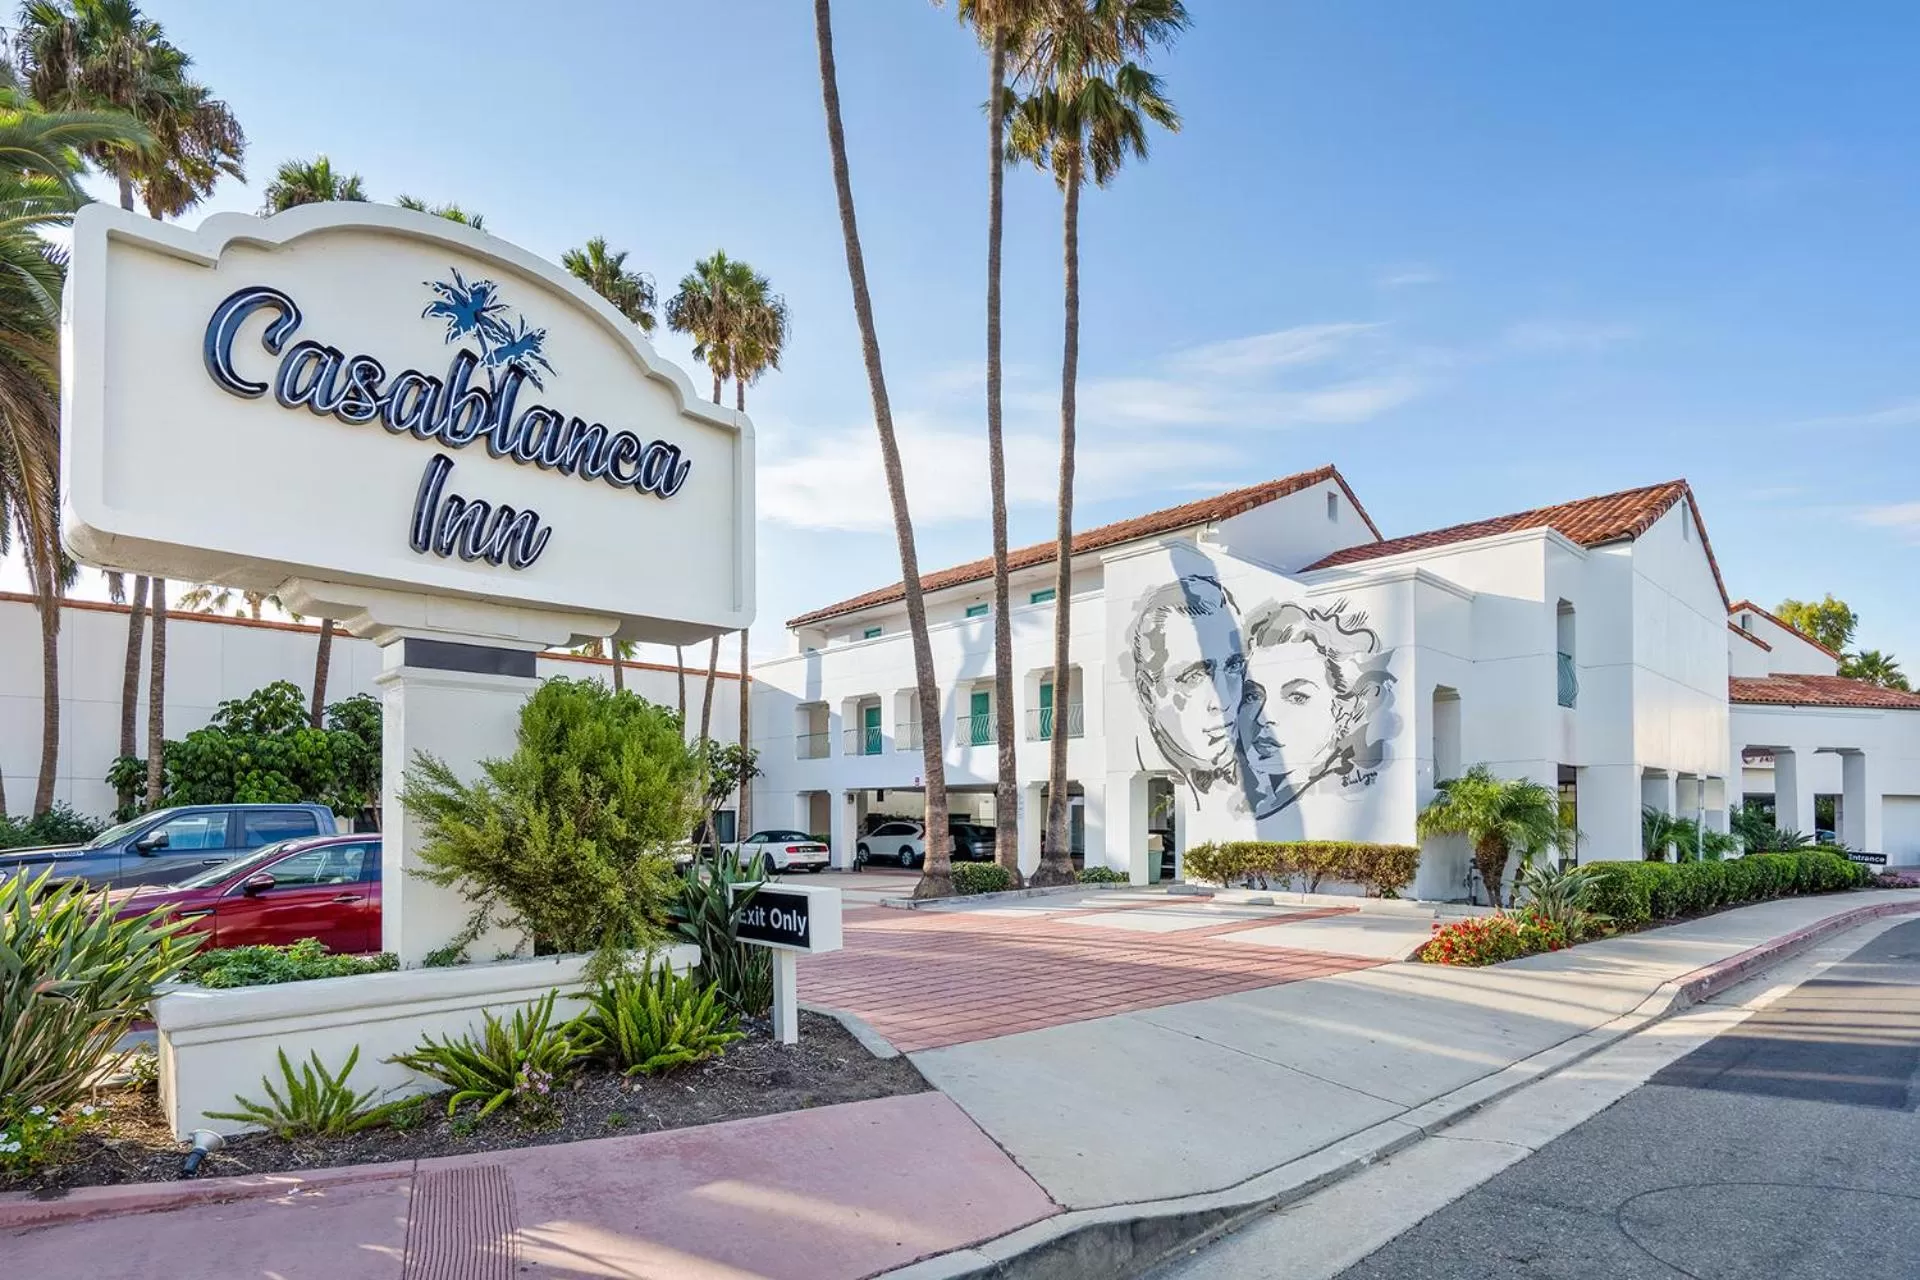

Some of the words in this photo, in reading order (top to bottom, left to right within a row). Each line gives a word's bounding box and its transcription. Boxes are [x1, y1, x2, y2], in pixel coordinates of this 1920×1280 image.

[203, 285, 691, 500] Casablanca
[409, 453, 552, 570] Inn
[1848, 853, 1885, 863] Entrance
[739, 906, 765, 927] Exit
[770, 907, 807, 937] Only
